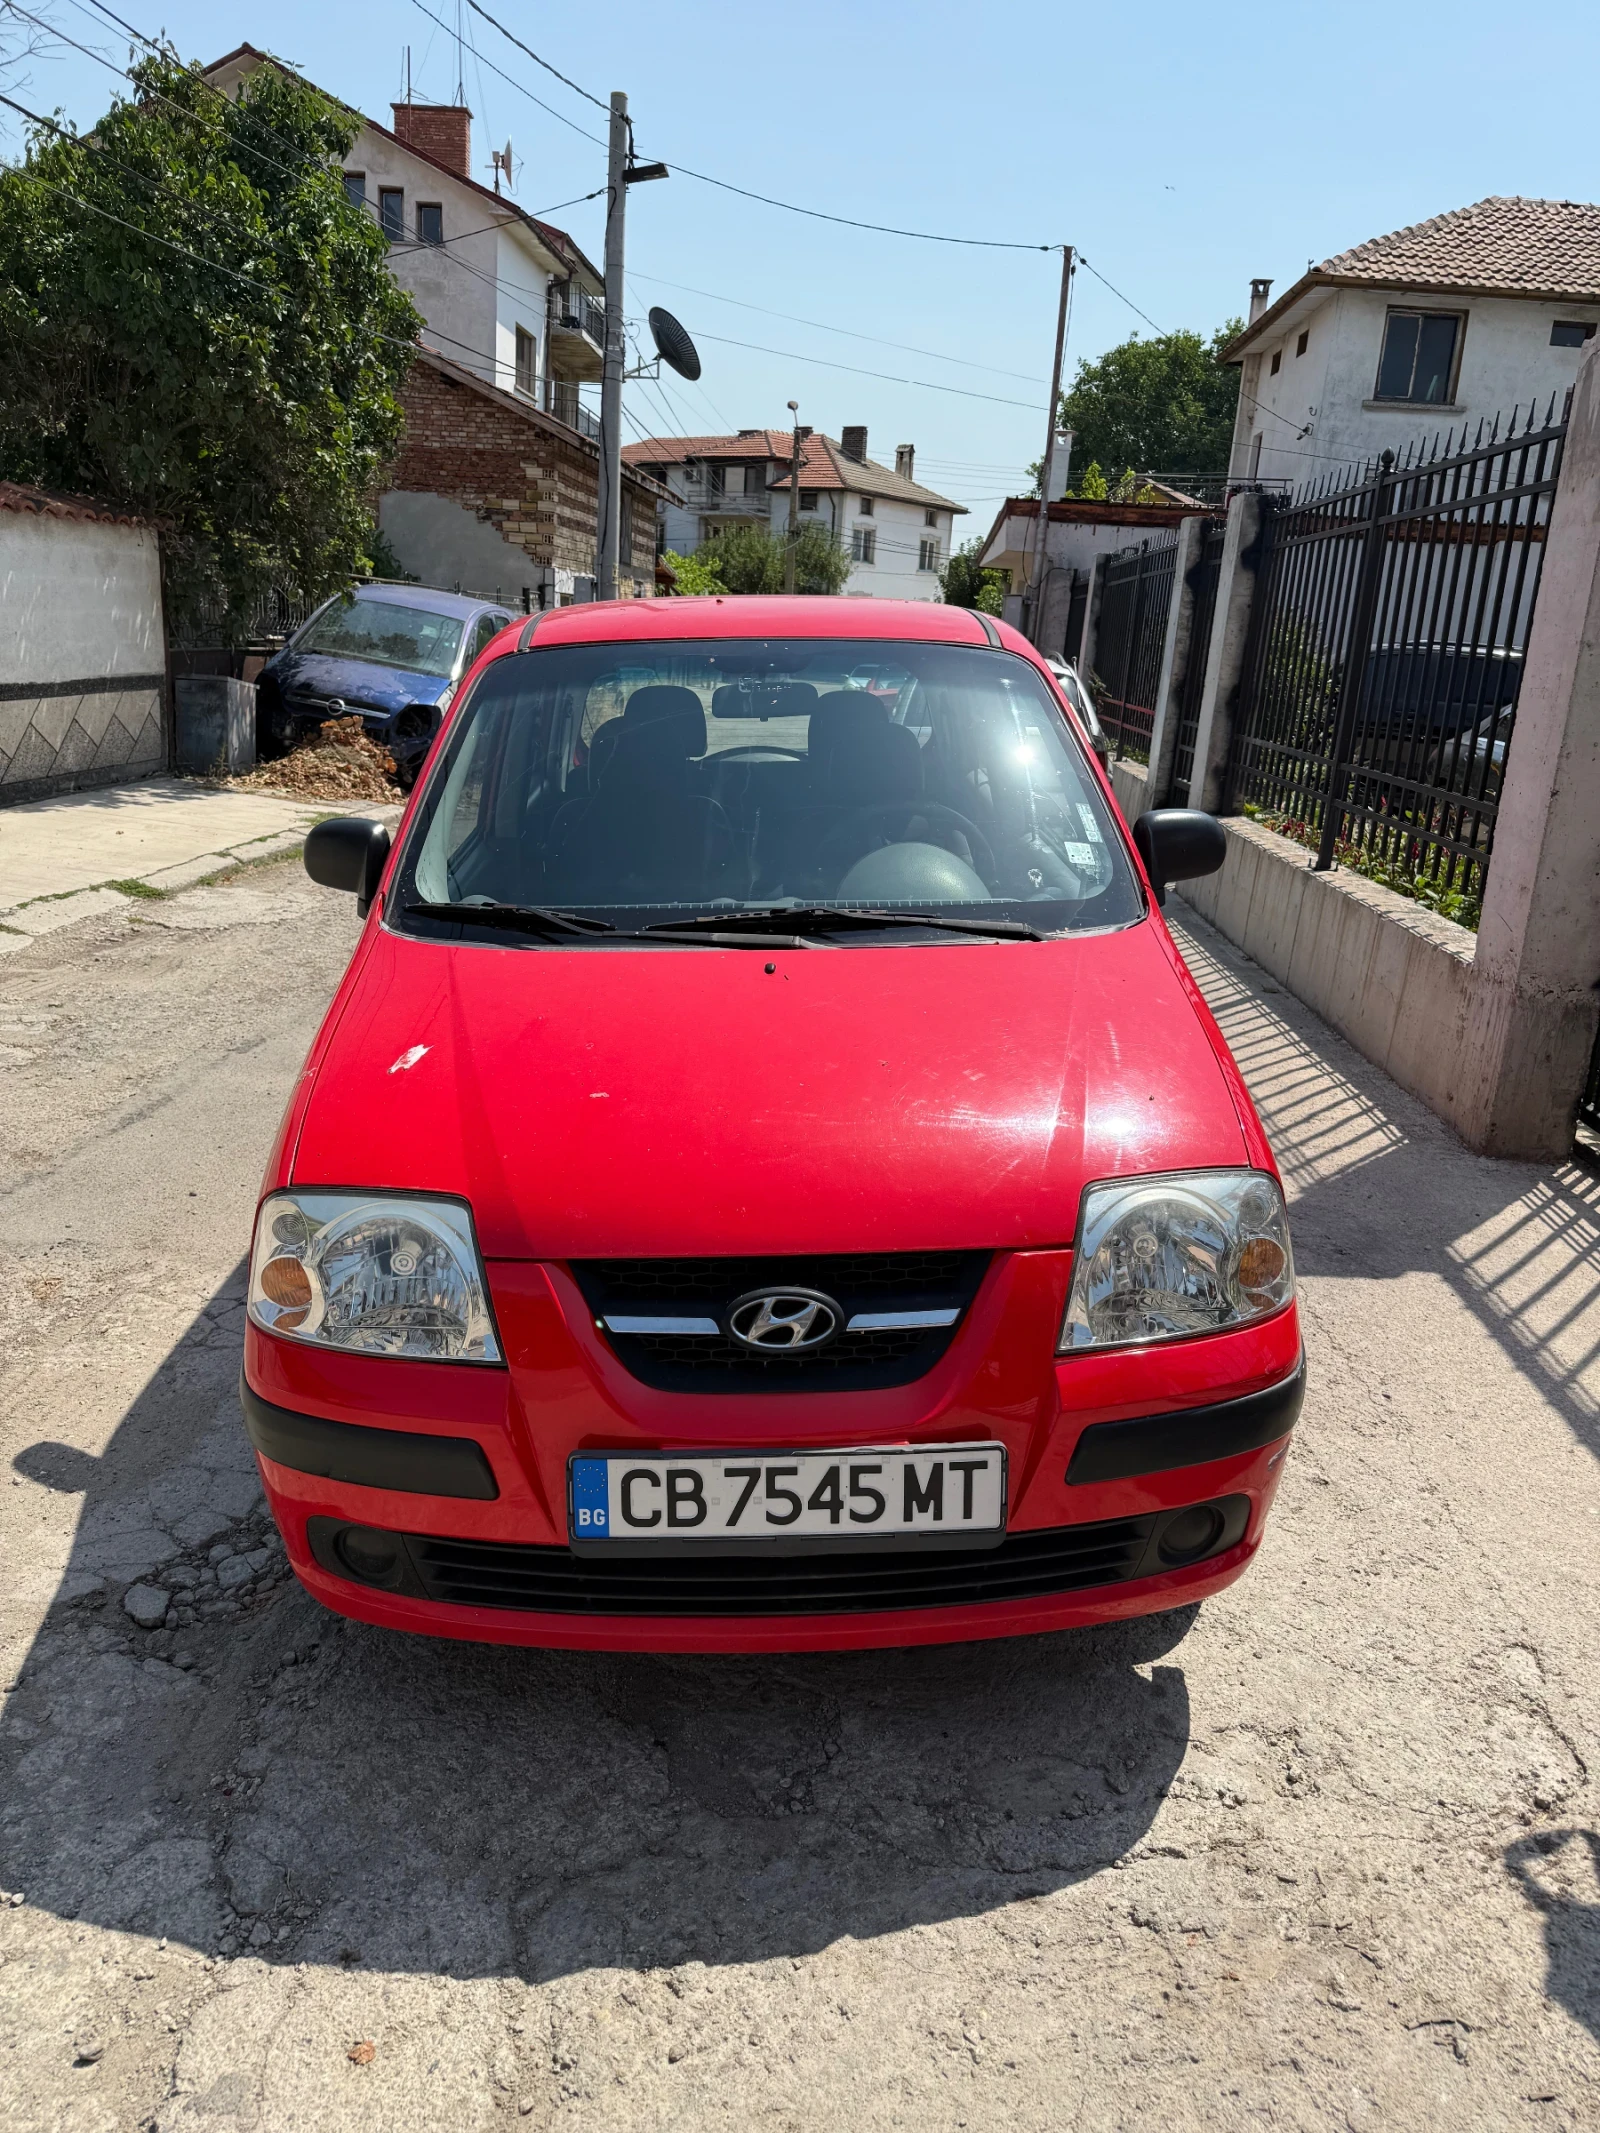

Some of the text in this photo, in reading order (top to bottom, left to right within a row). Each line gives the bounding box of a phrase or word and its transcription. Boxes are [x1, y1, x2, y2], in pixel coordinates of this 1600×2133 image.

[621, 1460, 988, 1528] CB 7545 MT
[578, 1508, 606, 1526] BG
